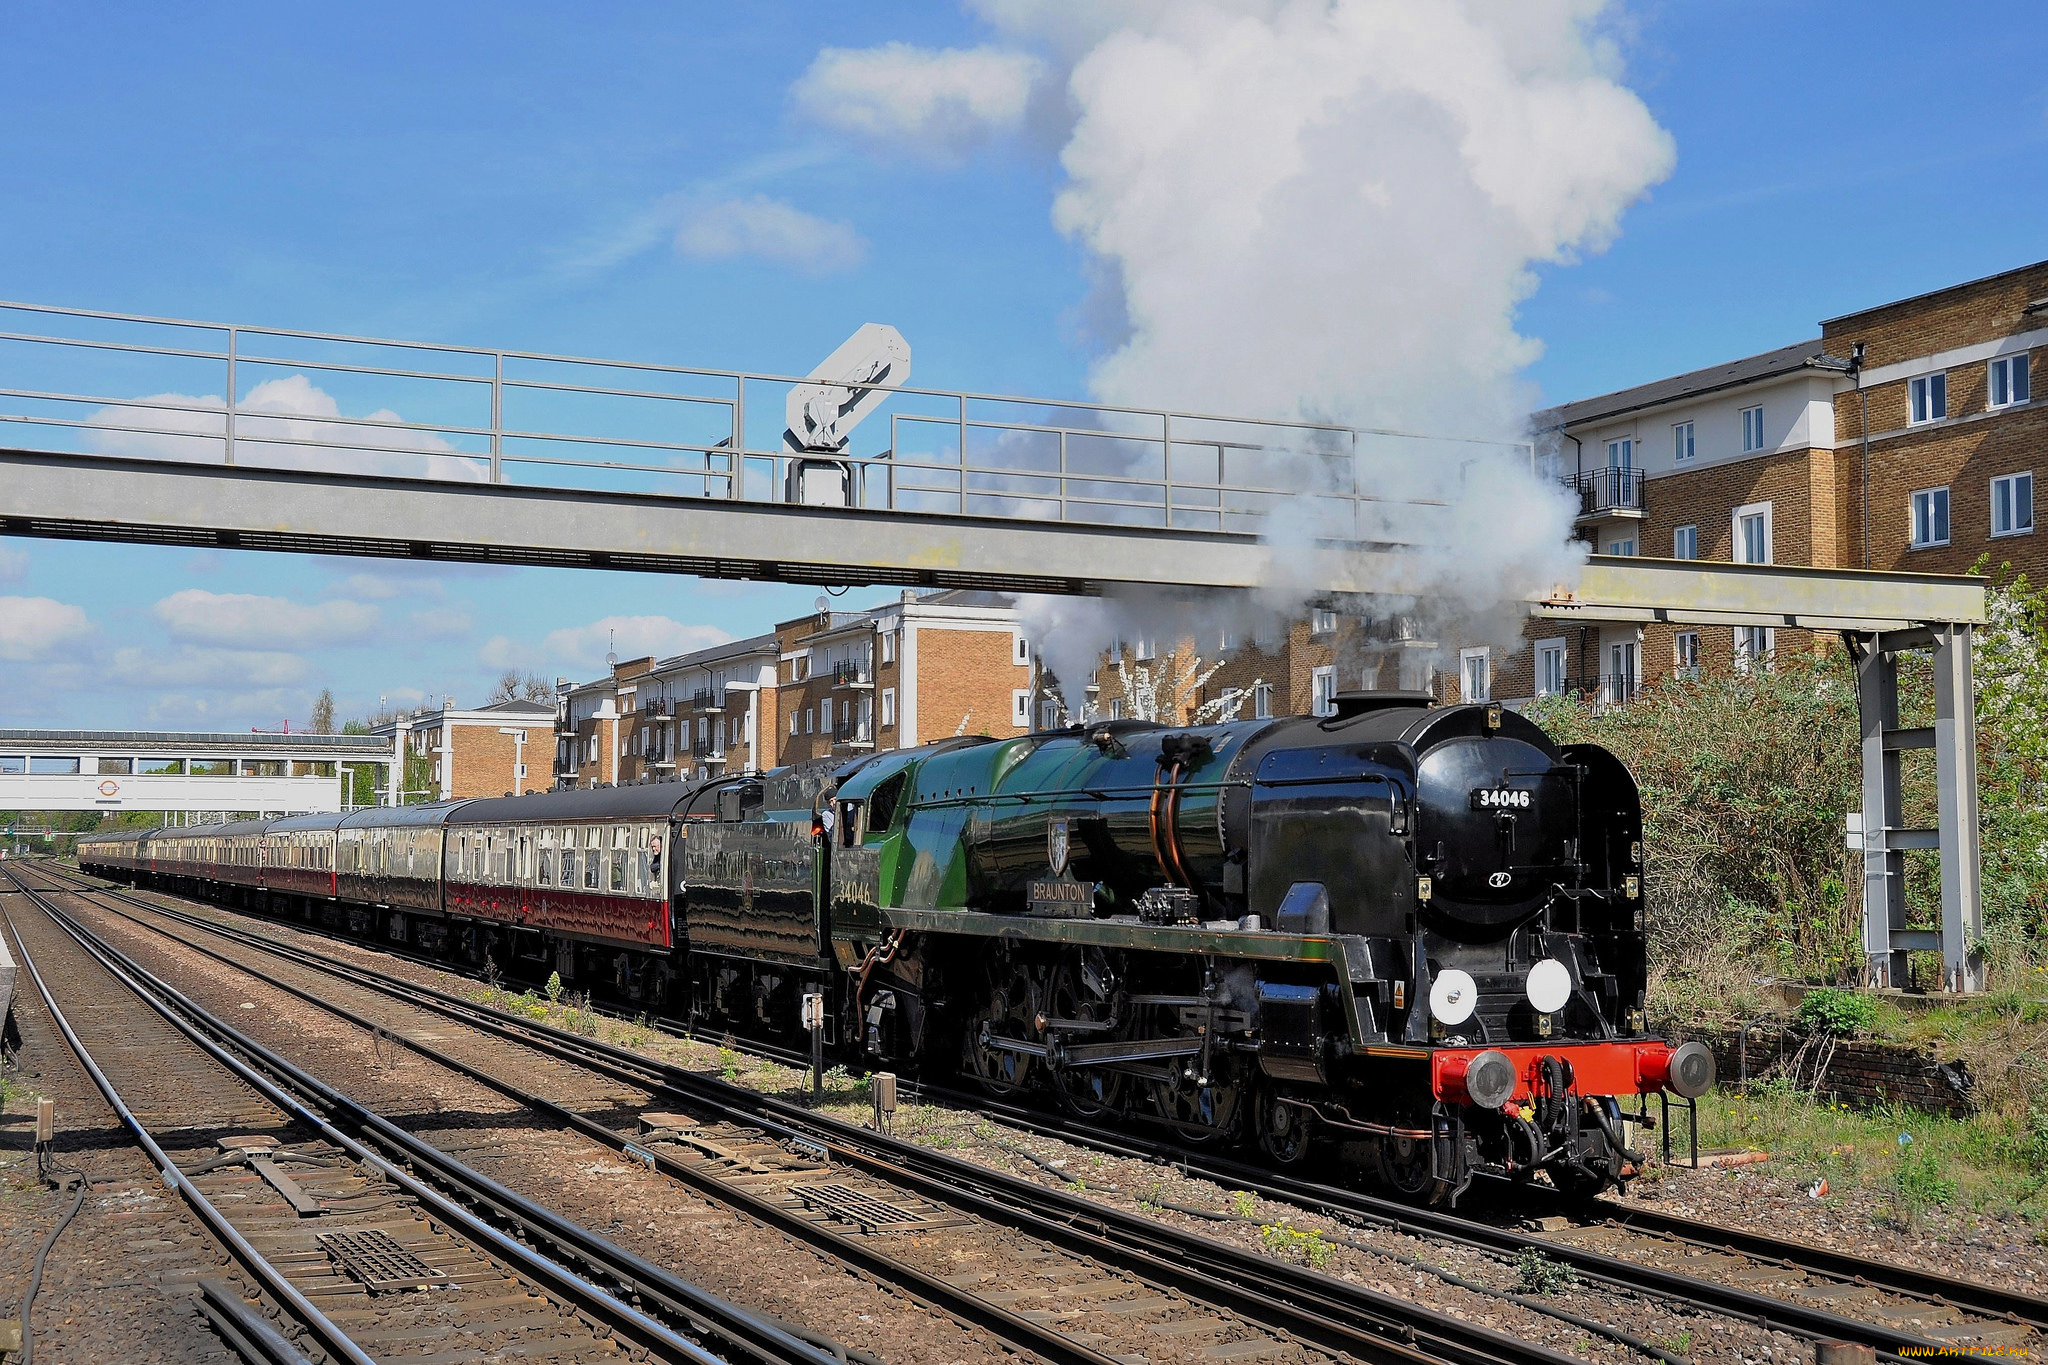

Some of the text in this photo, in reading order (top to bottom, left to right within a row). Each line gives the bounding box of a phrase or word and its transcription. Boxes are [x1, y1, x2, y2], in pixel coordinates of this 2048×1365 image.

[1480, 790, 1530, 807] 34046
[840, 880, 870, 905] 34046
[1033, 883, 1085, 901] BRAUNTON
